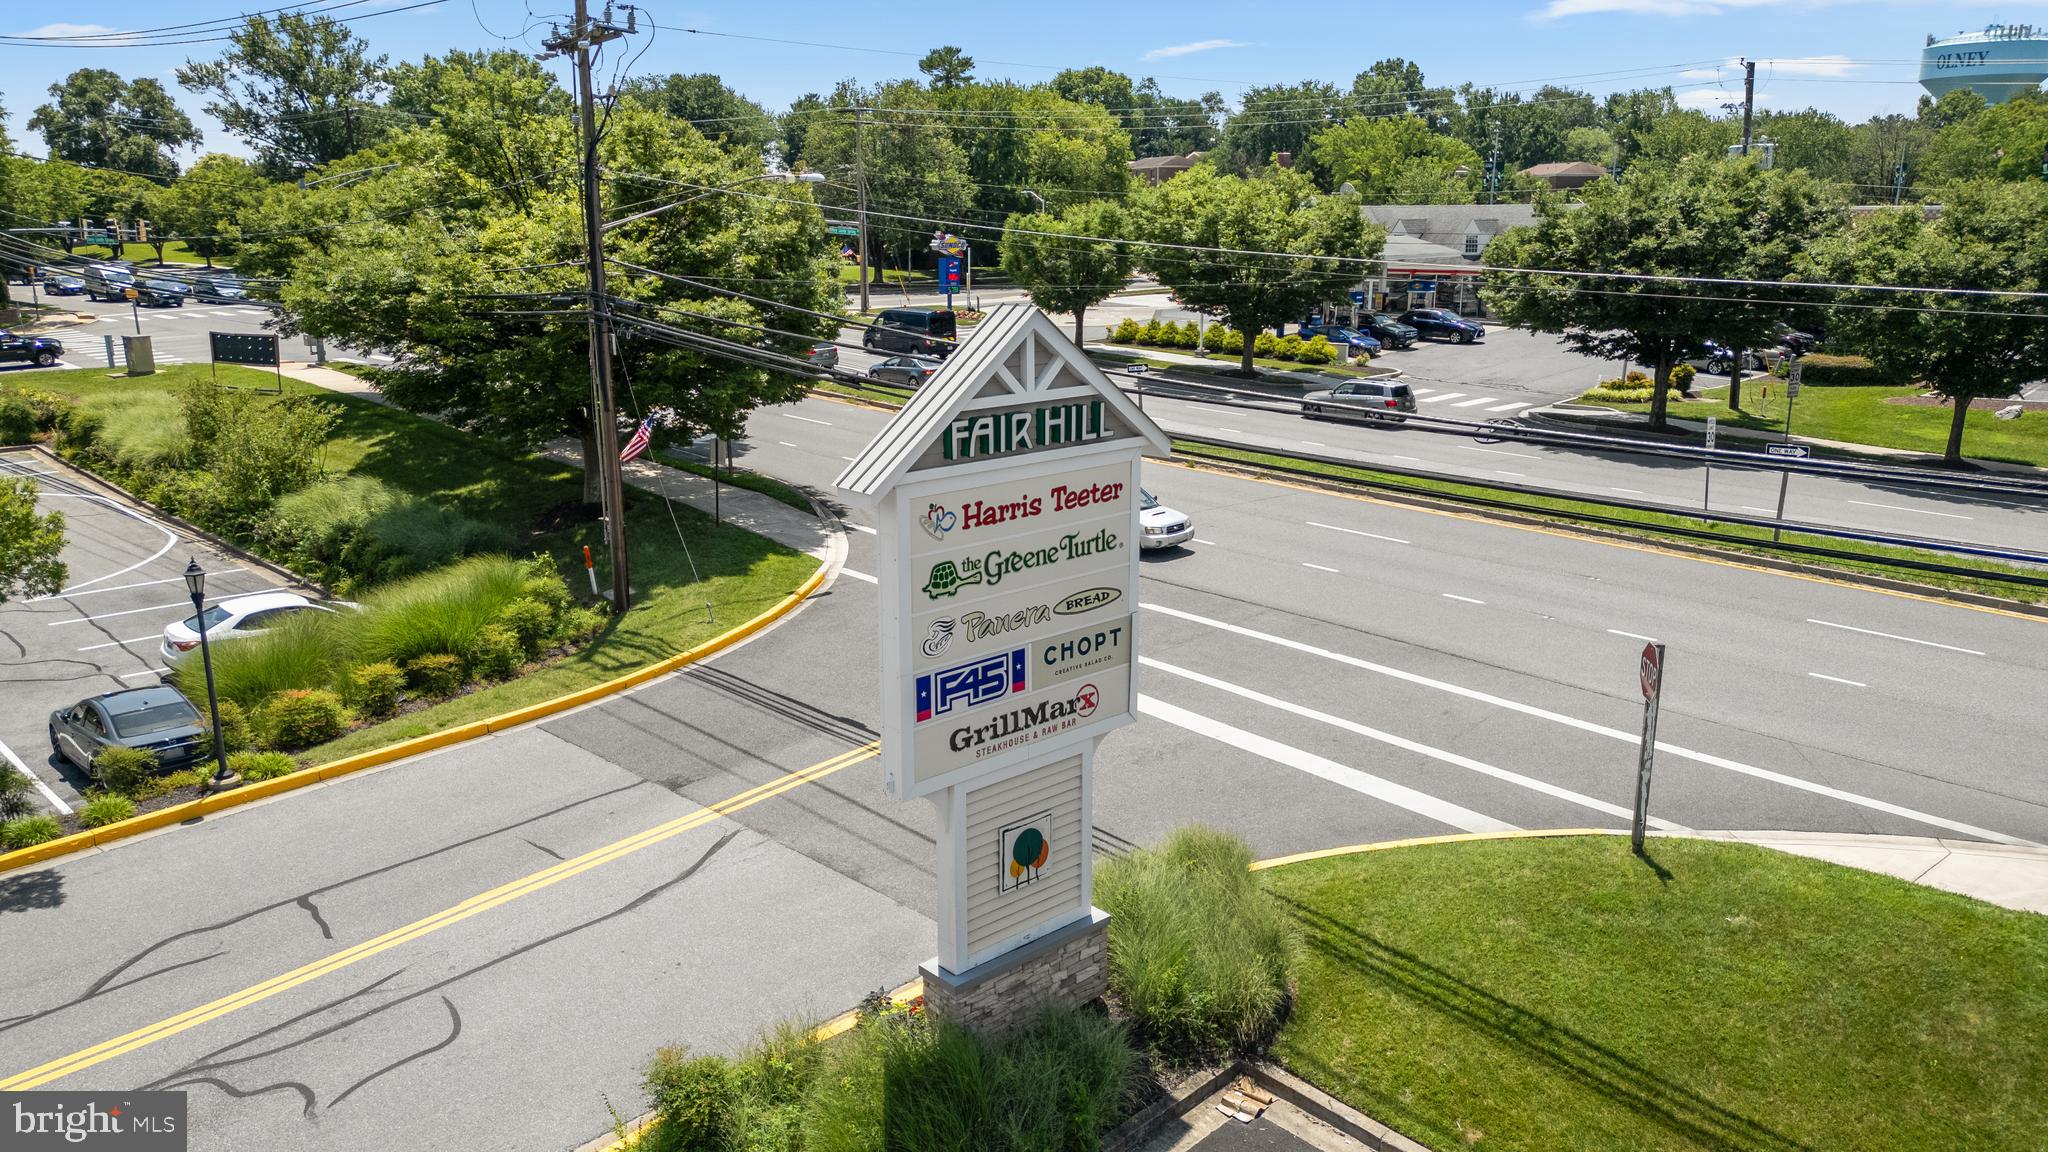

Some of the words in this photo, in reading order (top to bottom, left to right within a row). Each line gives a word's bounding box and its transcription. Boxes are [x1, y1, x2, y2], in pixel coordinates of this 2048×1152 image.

[1936, 51, 1990, 70] OLNEY
[940, 241, 966, 250] SUNOCO
[1790, 372, 1799, 381] 30
[943, 412, 1033, 460] FAIR
[1036, 401, 1114, 446] HILL
[1707, 431, 1714, 443] 30
[961, 495, 1042, 530] Harris
[1050, 483, 1123, 512] Teeter
[961, 556, 982, 573] the
[983, 545, 1059, 585] Greene
[1059, 528, 1117, 560] Turtle
[961, 605, 1051, 642] Panera
[1066, 591, 1110, 611] BREAD
[1043, 627, 1121, 665] CHOPT
[935, 653, 1009, 715] F45
[1054, 664, 1082, 676] CREATIVE
[1641, 656, 1657, 686] STOP
[976, 733, 1030, 758] STEAKHOUSE
[1033, 731, 1039, 739] &
[1041, 724, 1058, 736] RAW
[1061, 718, 1077, 729] BAR
